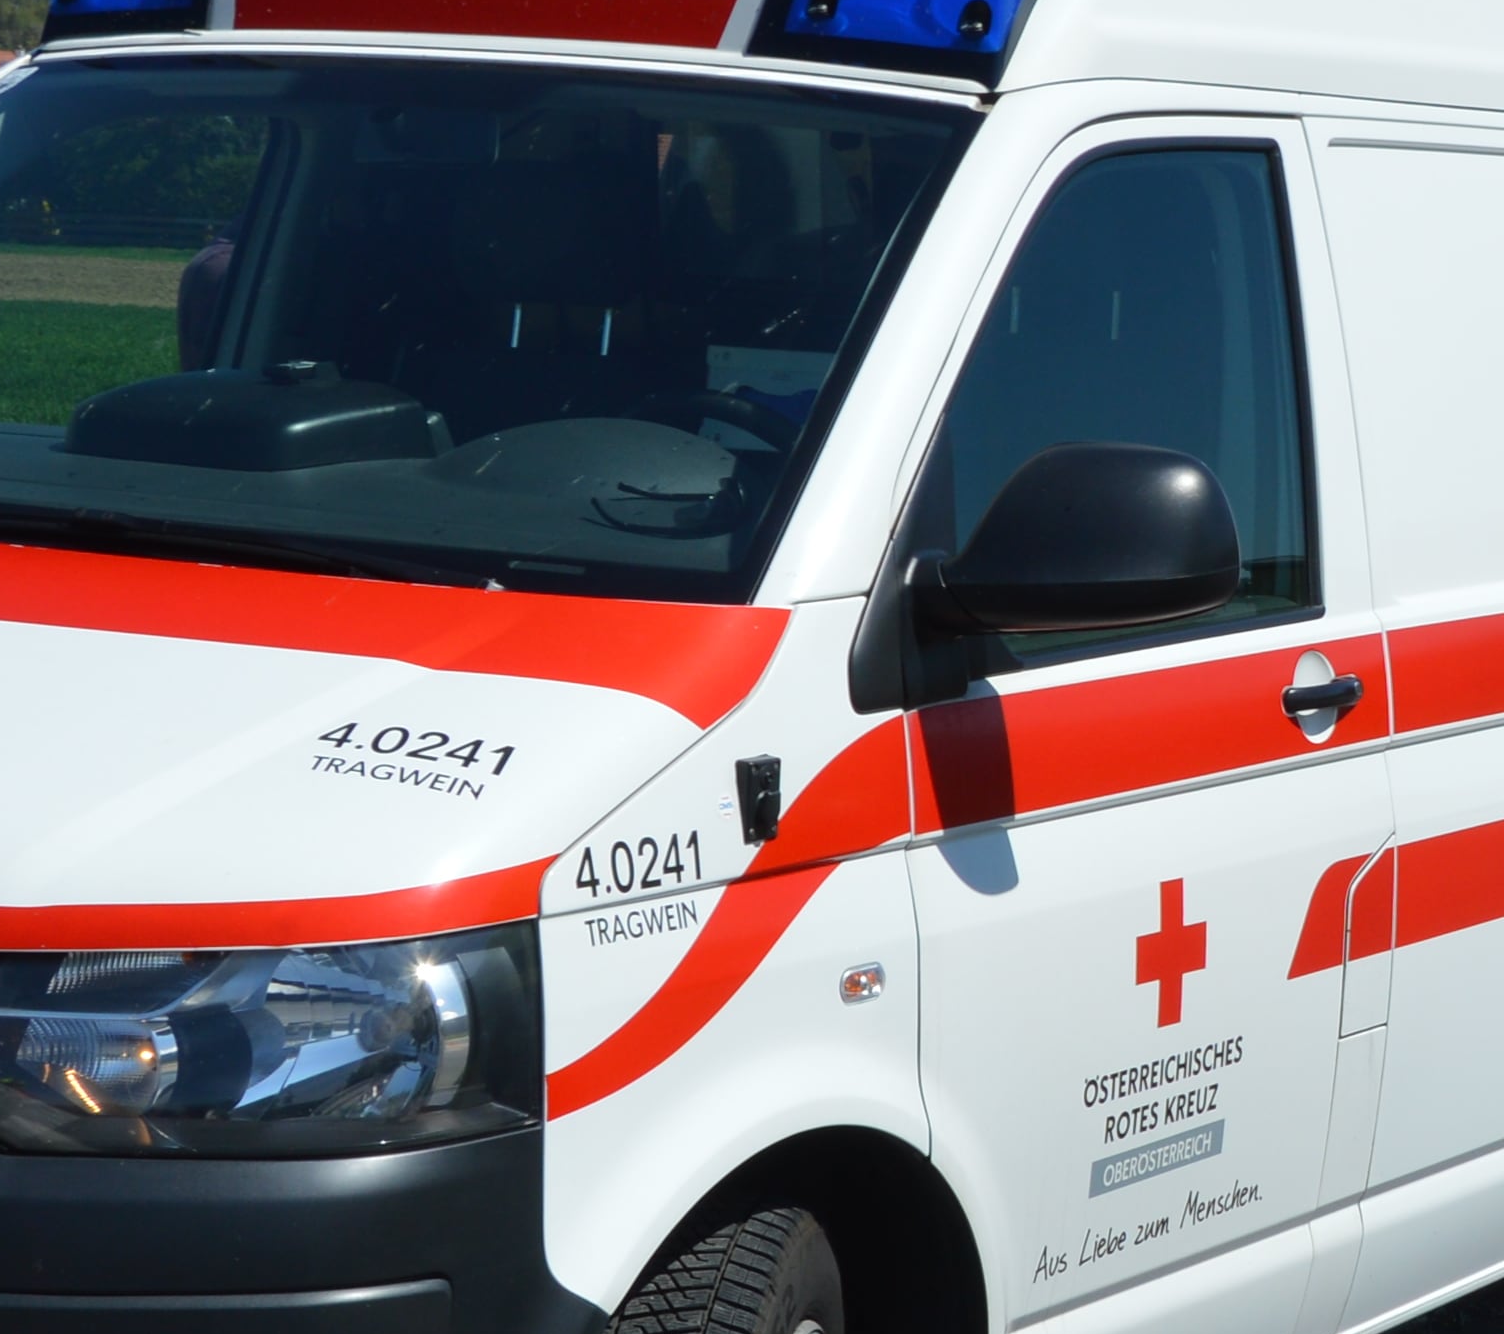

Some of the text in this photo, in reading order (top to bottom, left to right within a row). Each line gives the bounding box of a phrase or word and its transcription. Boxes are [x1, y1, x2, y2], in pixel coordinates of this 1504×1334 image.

[310, 754, 485, 800] TRAGWEIN
[317, 721, 517, 777] 4.0241
[575, 829, 702, 898] 4.0241
[584, 900, 698, 947] TRAGWEIN
[1083, 1036, 1244, 1108] ÖSTERREICHISCHES
[1103, 1083, 1219, 1144] ROTES KREUZ
[1102, 1130, 1213, 1187] OBERÖSTERREICH
[1033, 1179, 1263, 1284] Aus Liebe zum Menschen.
